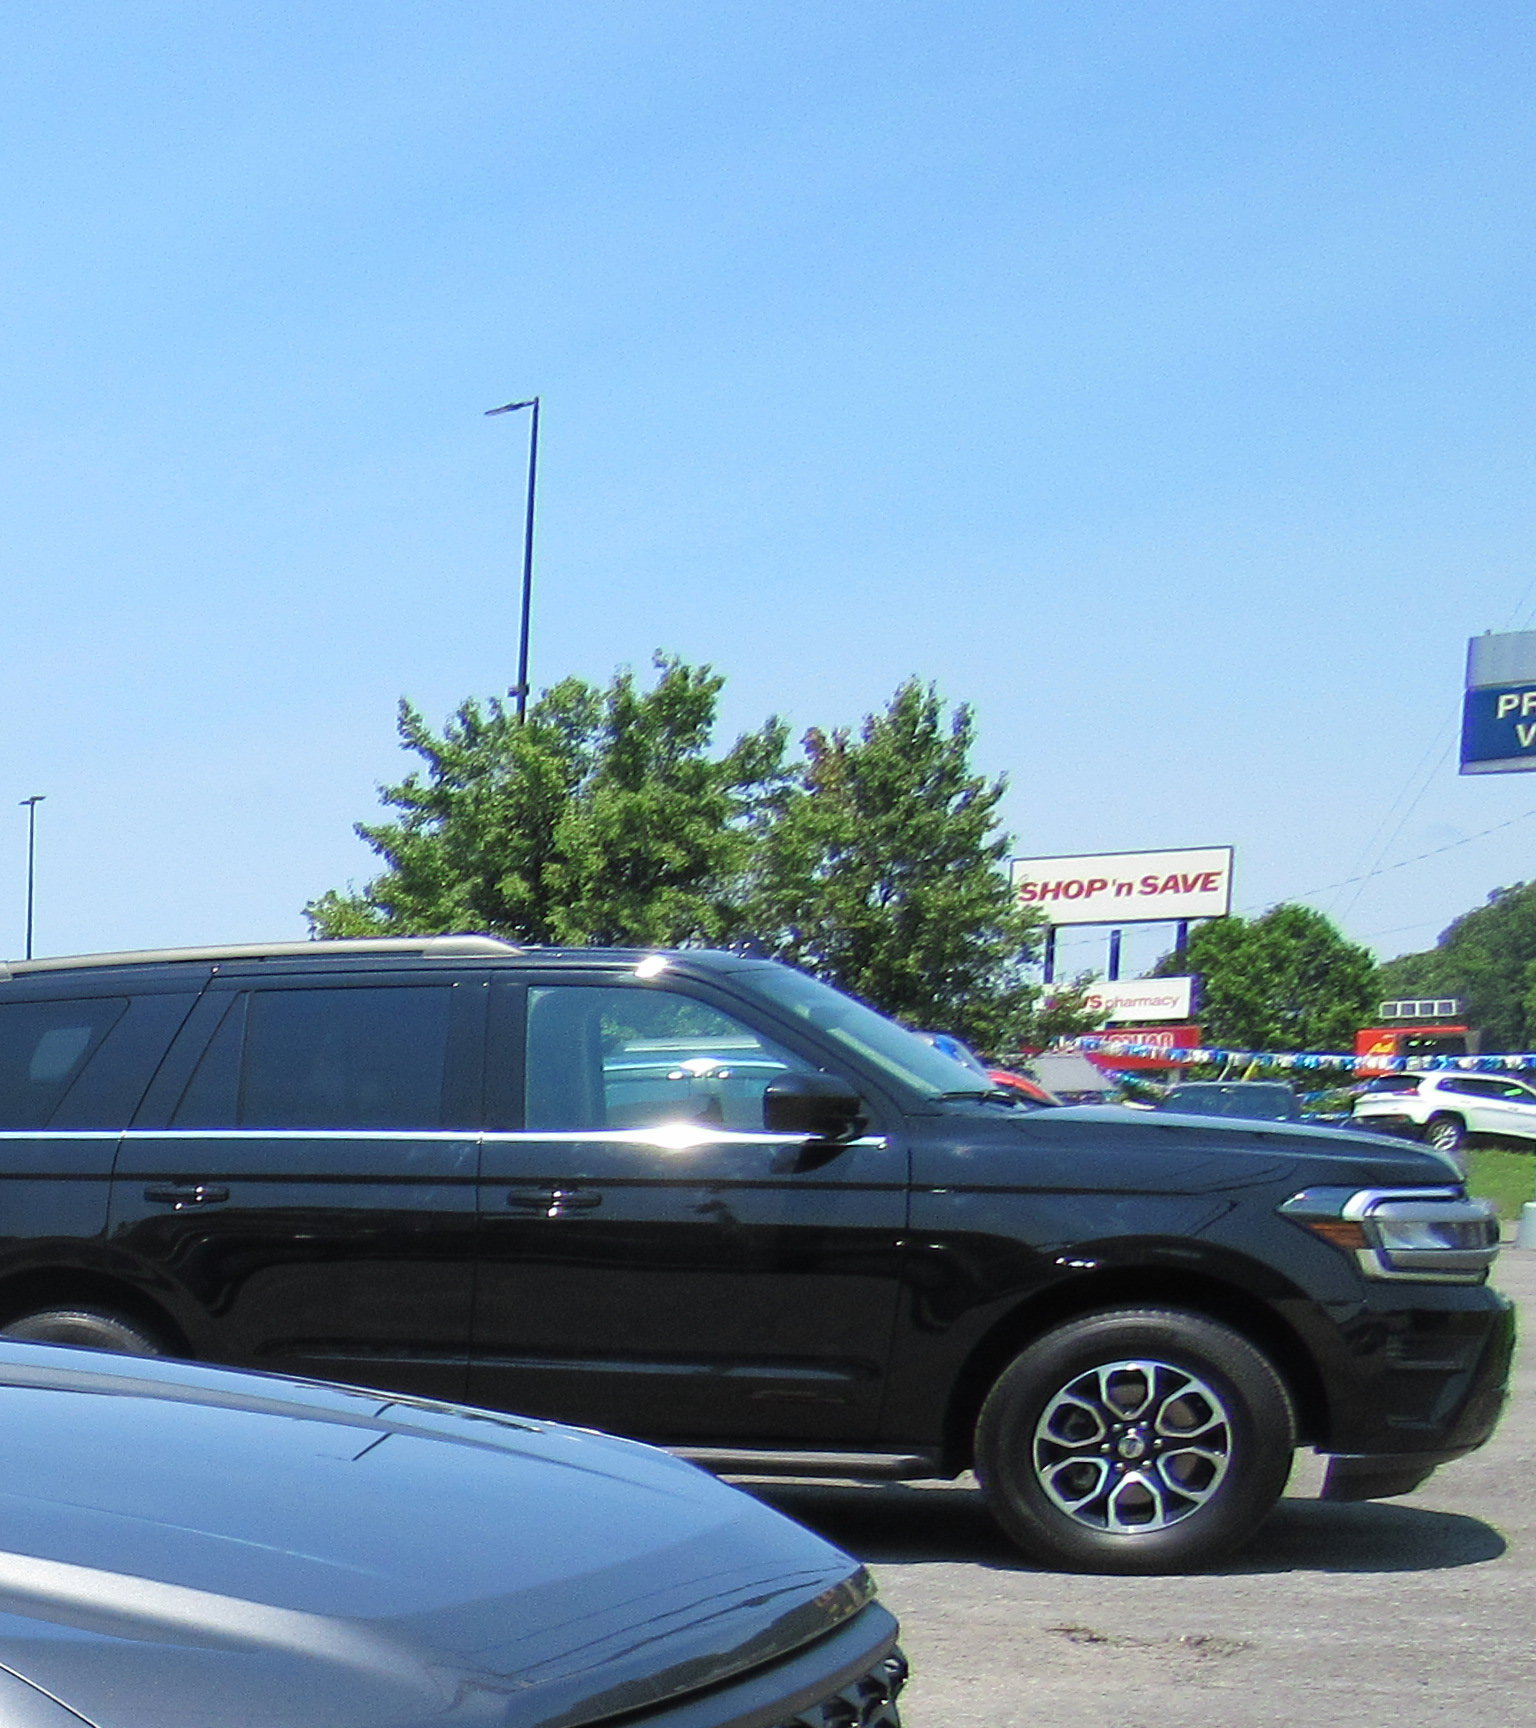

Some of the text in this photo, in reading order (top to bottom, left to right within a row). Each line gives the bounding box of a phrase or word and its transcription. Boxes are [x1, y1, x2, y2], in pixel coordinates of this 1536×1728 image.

[1018, 878, 1109, 903] SHOP
[1138, 870, 1224, 896] SAVE
[1105, 994, 1181, 1010] pharmacy
